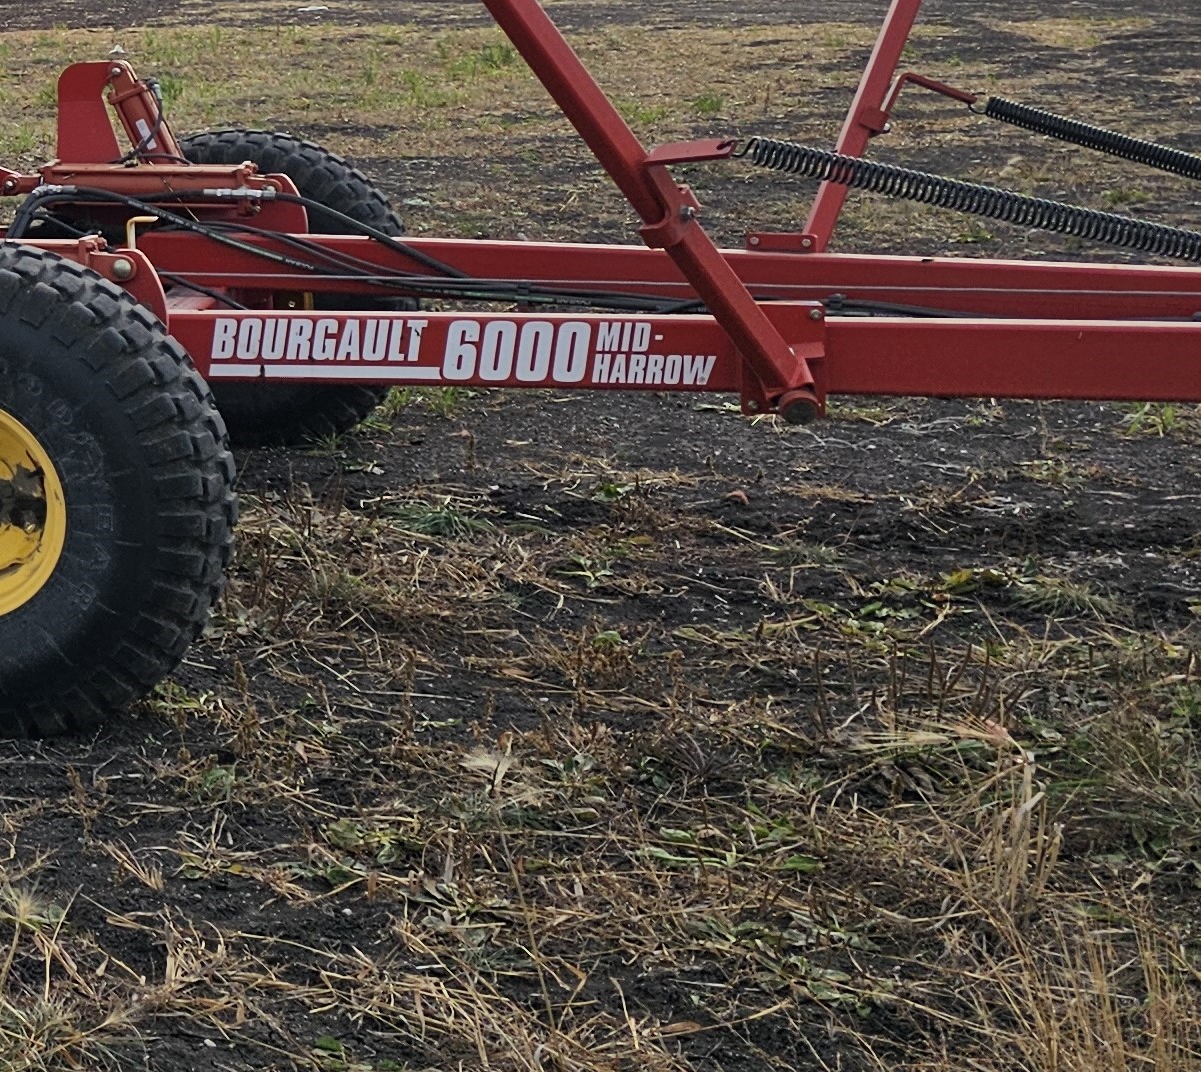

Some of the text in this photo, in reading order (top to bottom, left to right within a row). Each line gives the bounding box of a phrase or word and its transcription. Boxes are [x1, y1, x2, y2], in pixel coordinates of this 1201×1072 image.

[210, 318, 591, 382] BOURGAULT 6000
[596, 321, 664, 352] MID-
[593, 354, 716, 385] HARROW
